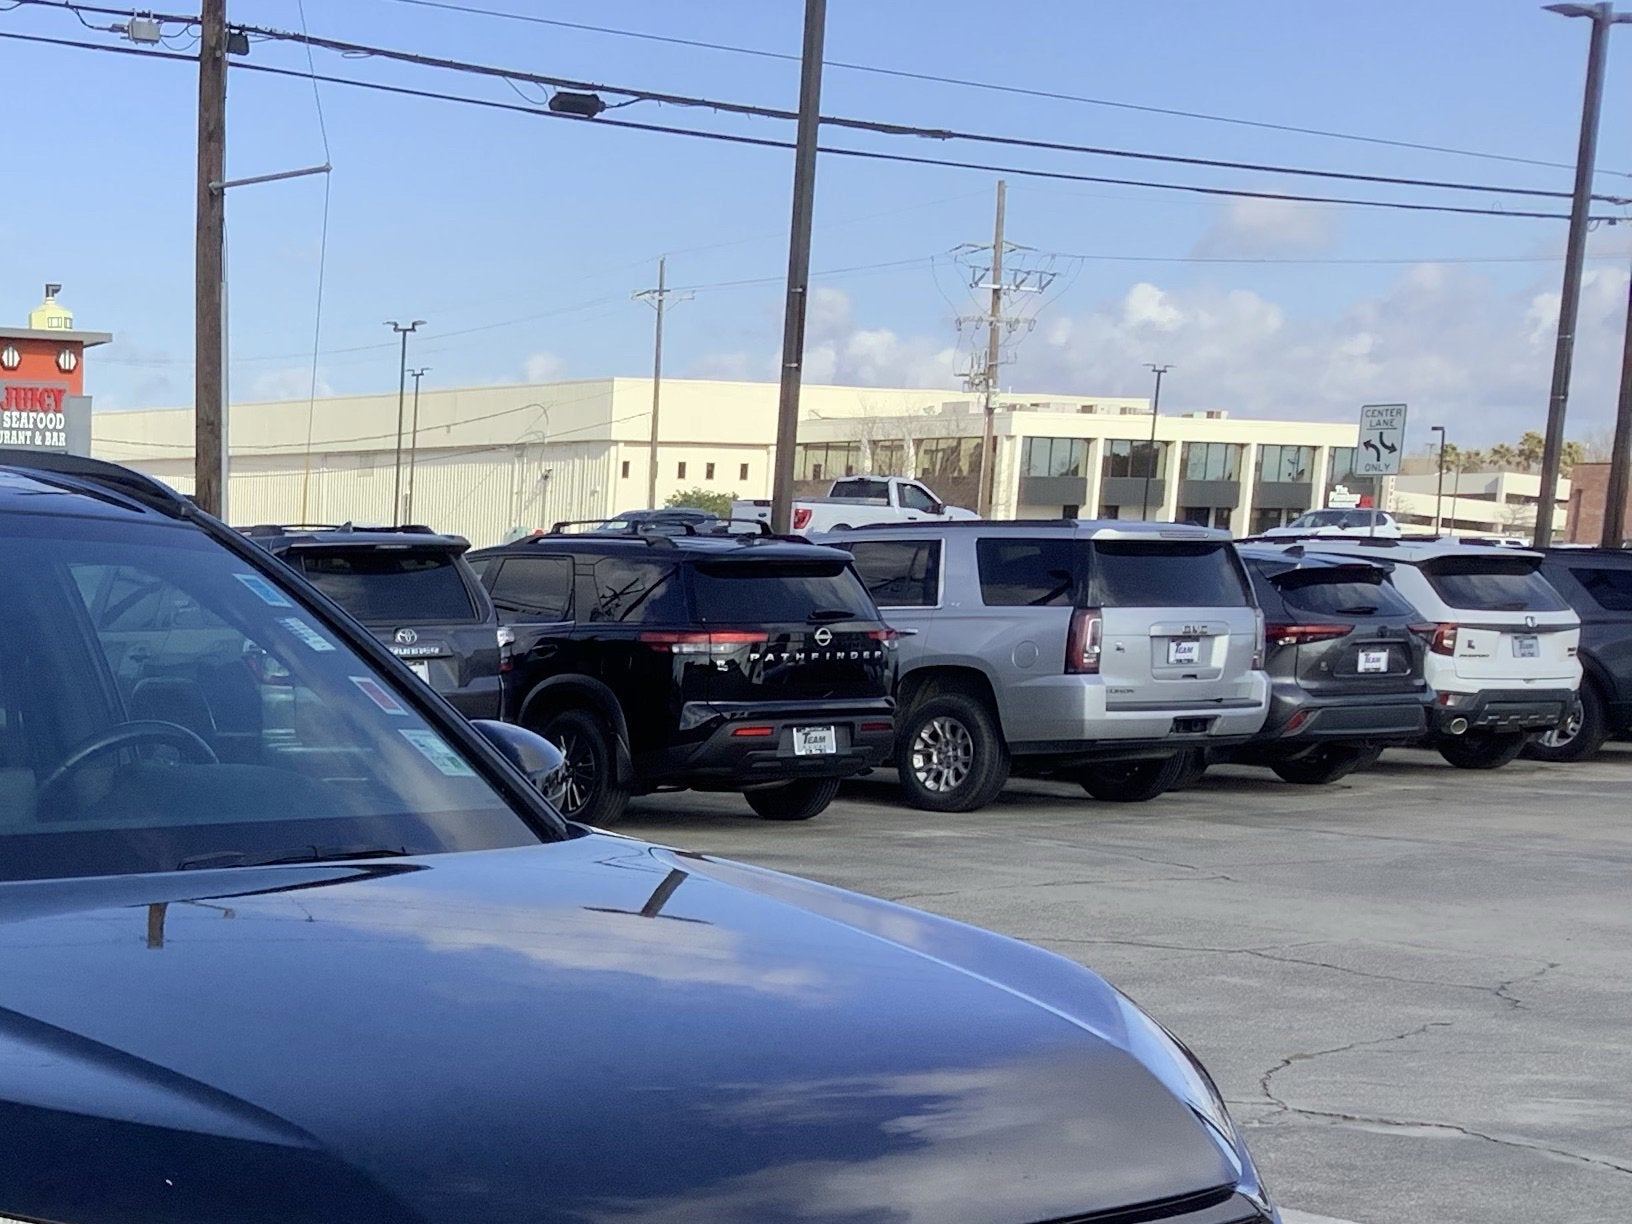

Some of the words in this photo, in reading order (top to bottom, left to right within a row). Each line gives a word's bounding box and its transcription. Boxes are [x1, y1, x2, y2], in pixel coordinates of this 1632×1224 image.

[0, 386, 66, 412] JUICY
[1365, 408, 1402, 418] CENTER
[3, 411, 65, 430] SEAFOOD
[1369, 419, 1396, 428] LANE
[34, 431, 43, 446] &
[45, 431, 66, 447] BAR
[1364, 463, 1391, 472] ONLY
[389, 647, 439, 655] RUNNER
[750, 651, 882, 661] PATHFINDER
[802, 732, 826, 744] TEAM
